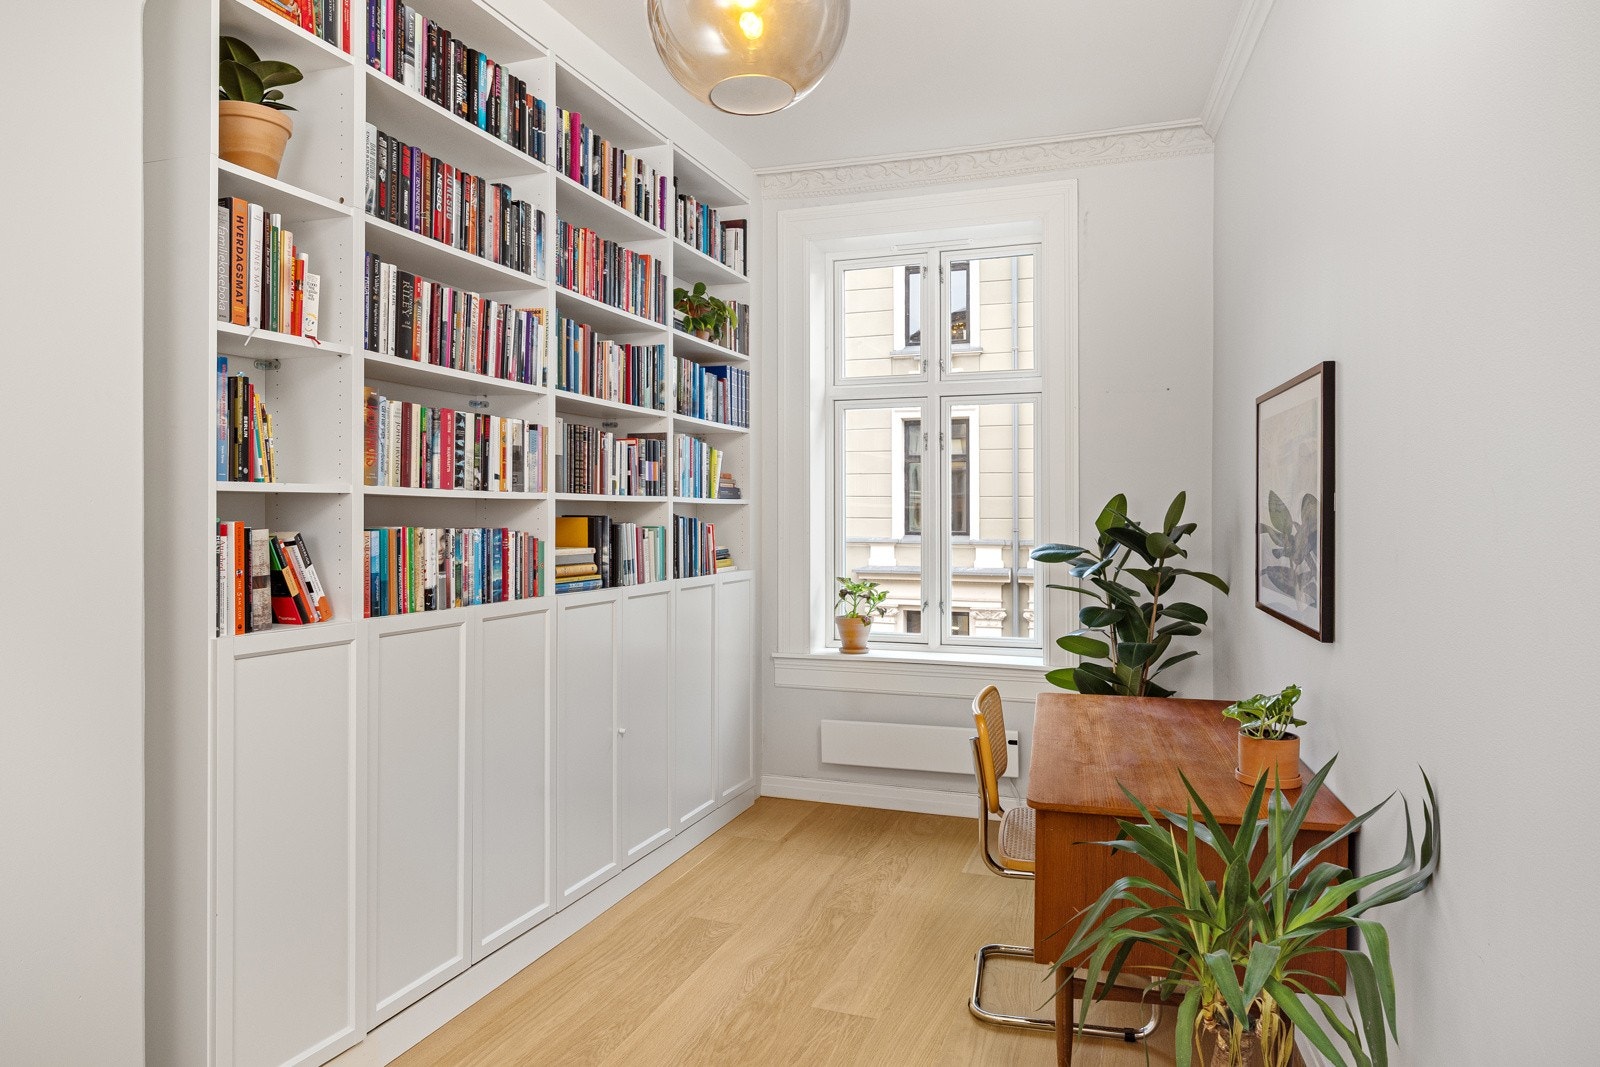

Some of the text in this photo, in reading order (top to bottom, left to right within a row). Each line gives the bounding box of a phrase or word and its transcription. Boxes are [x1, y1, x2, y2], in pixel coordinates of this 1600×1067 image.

[446, 173, 452, 185] JO
[218, 225, 228, 311] familiekokeboka
[235, 215, 244, 304] HVERDAGSMAT
